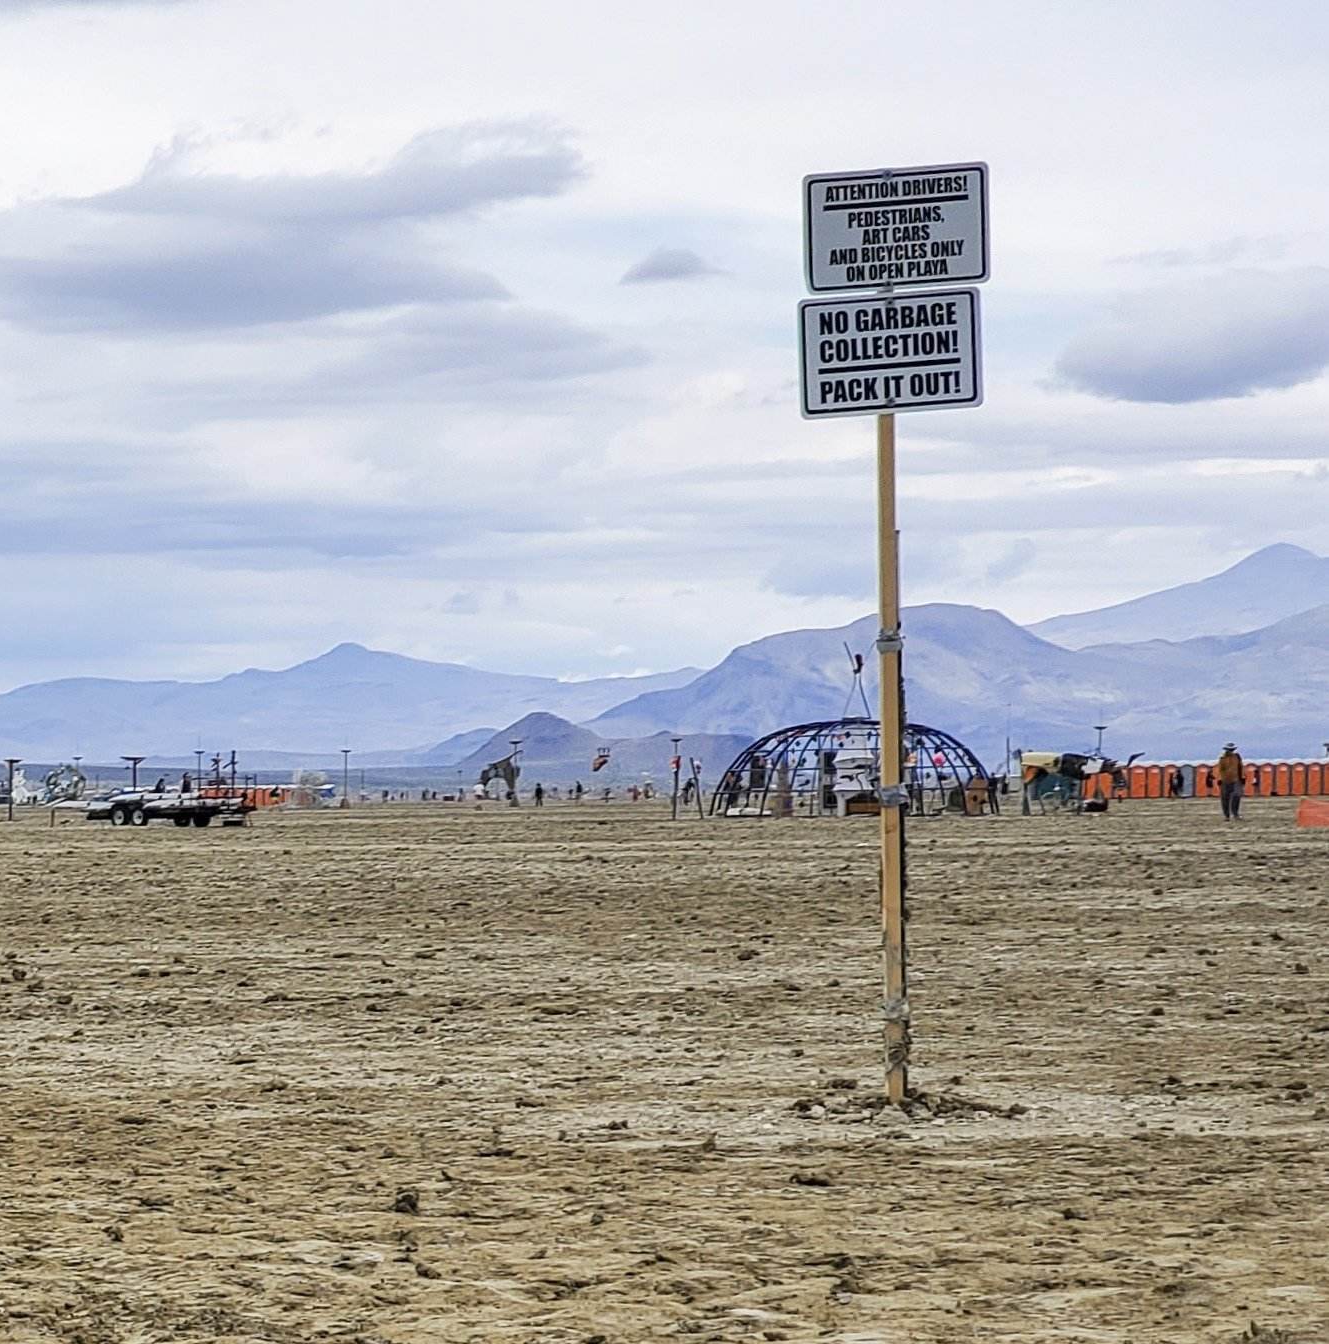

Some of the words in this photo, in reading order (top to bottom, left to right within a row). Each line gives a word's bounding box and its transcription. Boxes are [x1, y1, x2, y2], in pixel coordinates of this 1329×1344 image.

[826, 181, 899, 202] ATTENTION
[903, 175, 968, 196] DRIVERS!
[848, 205, 945, 229] PEDESTRIANS,
[862, 227, 890, 246] ART
[893, 224, 930, 243] CARS
[829, 248, 858, 266] AND
[862, 241, 928, 264] BICYCLES
[931, 239, 965, 257] ONLY
[846, 265, 865, 283] ON
[869, 262, 904, 281] OPEN
[908, 258, 949, 278] PLAYA
[820, 310, 849, 335] NO
[855, 302, 958, 333] GARBAGE
[820, 330, 959, 364] COLLECTION!
[820, 376, 879, 405] PACK
[884, 374, 904, 399] IT
[910, 370, 961, 397] OUT!
